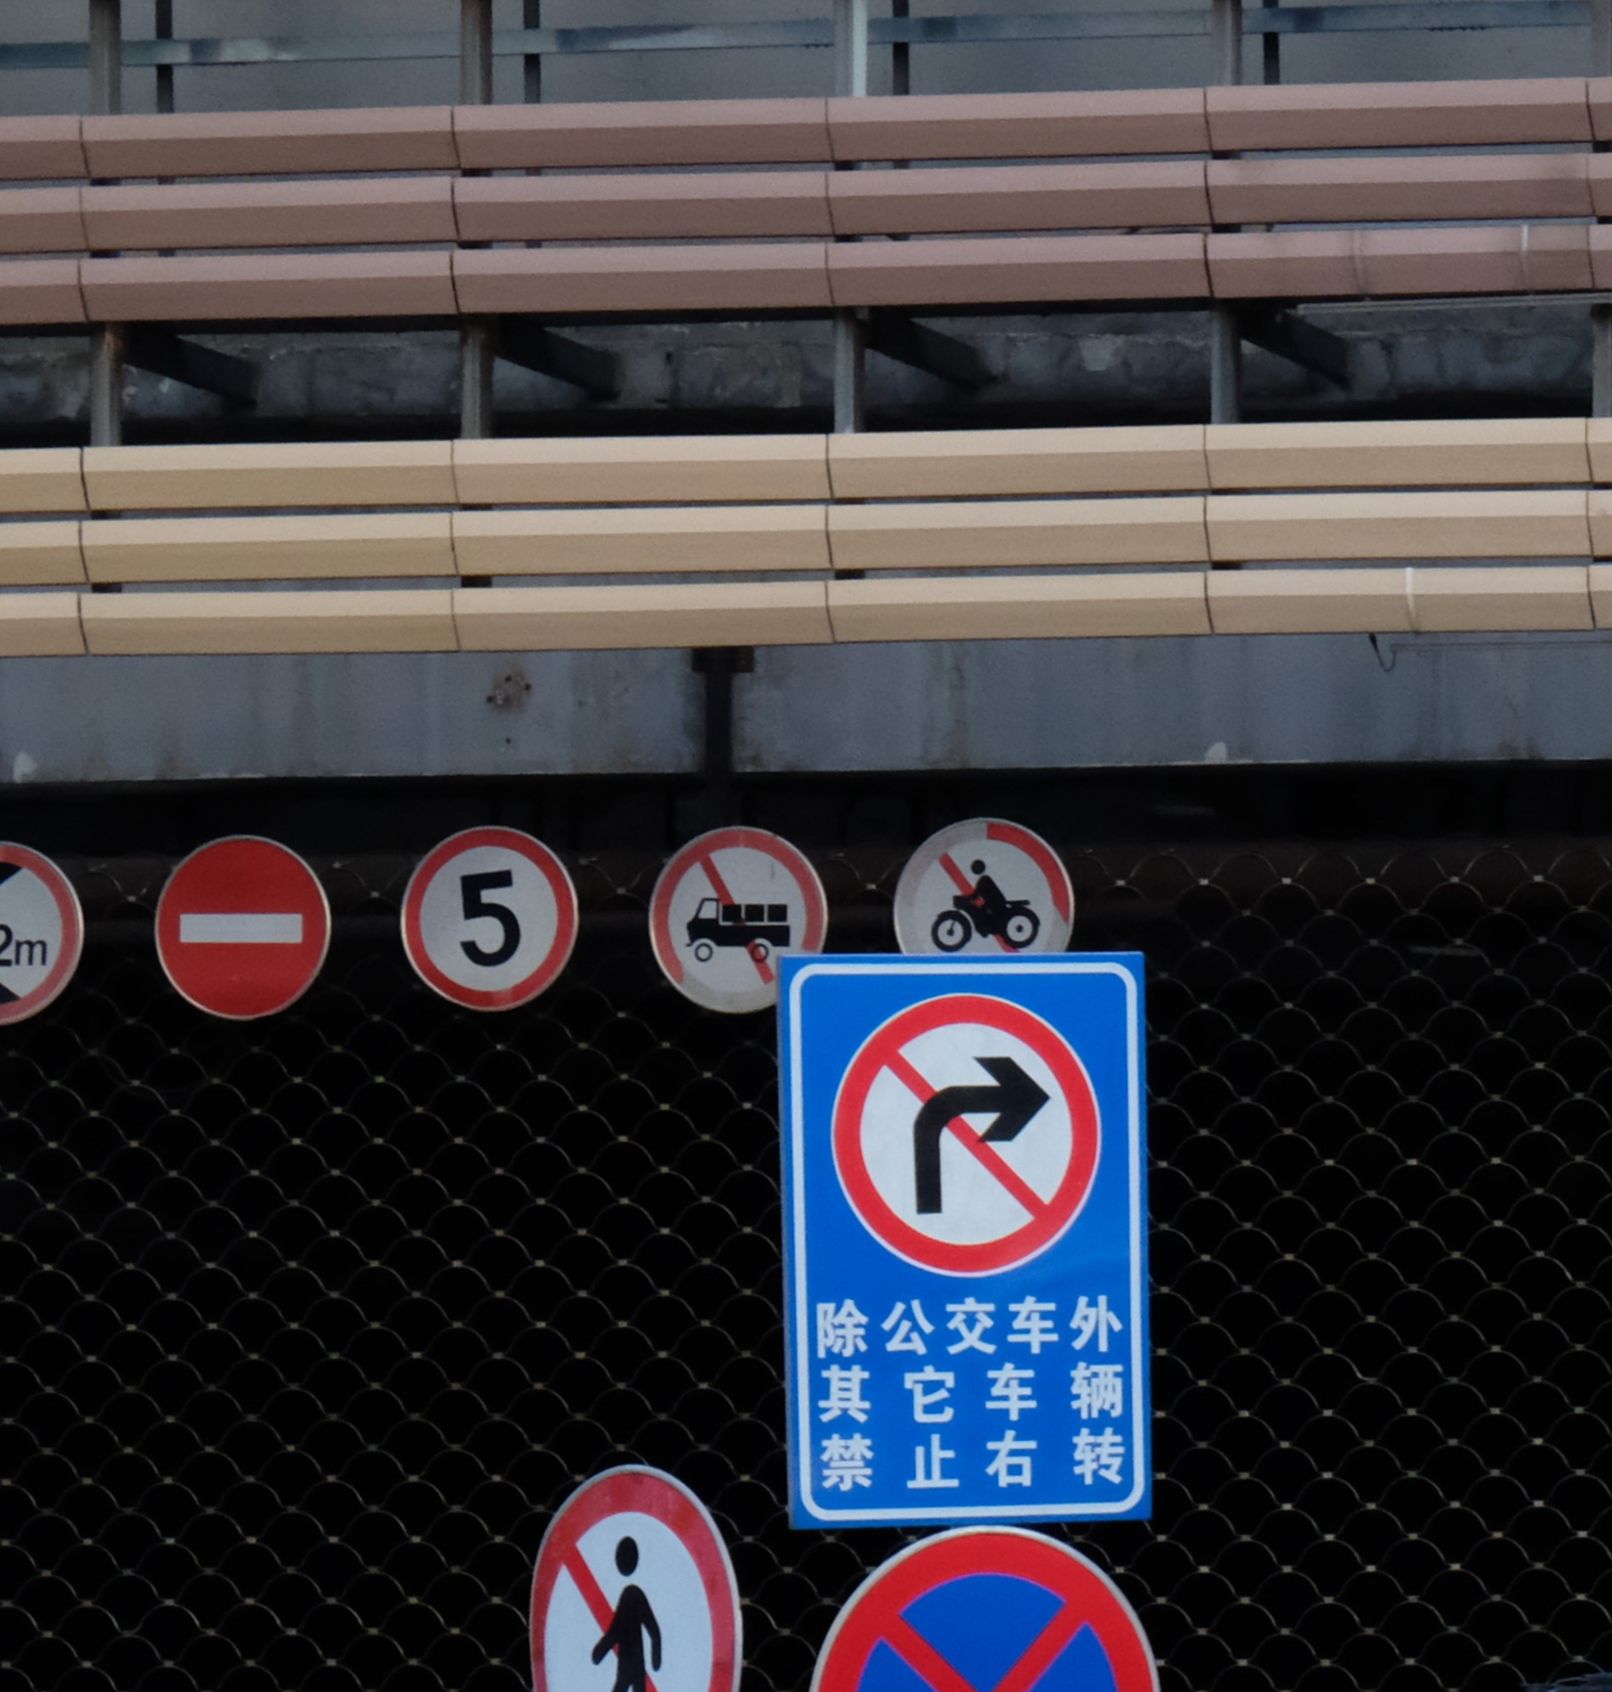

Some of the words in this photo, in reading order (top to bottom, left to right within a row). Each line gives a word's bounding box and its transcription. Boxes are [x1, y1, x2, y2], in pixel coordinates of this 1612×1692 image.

[459, 870, 521, 967] 5
[815, 1295, 1123, 1357] 除公交车外
[818, 1361, 1124, 1423] 其它车辆
[820, 1427, 1125, 1490] 禁止右转
